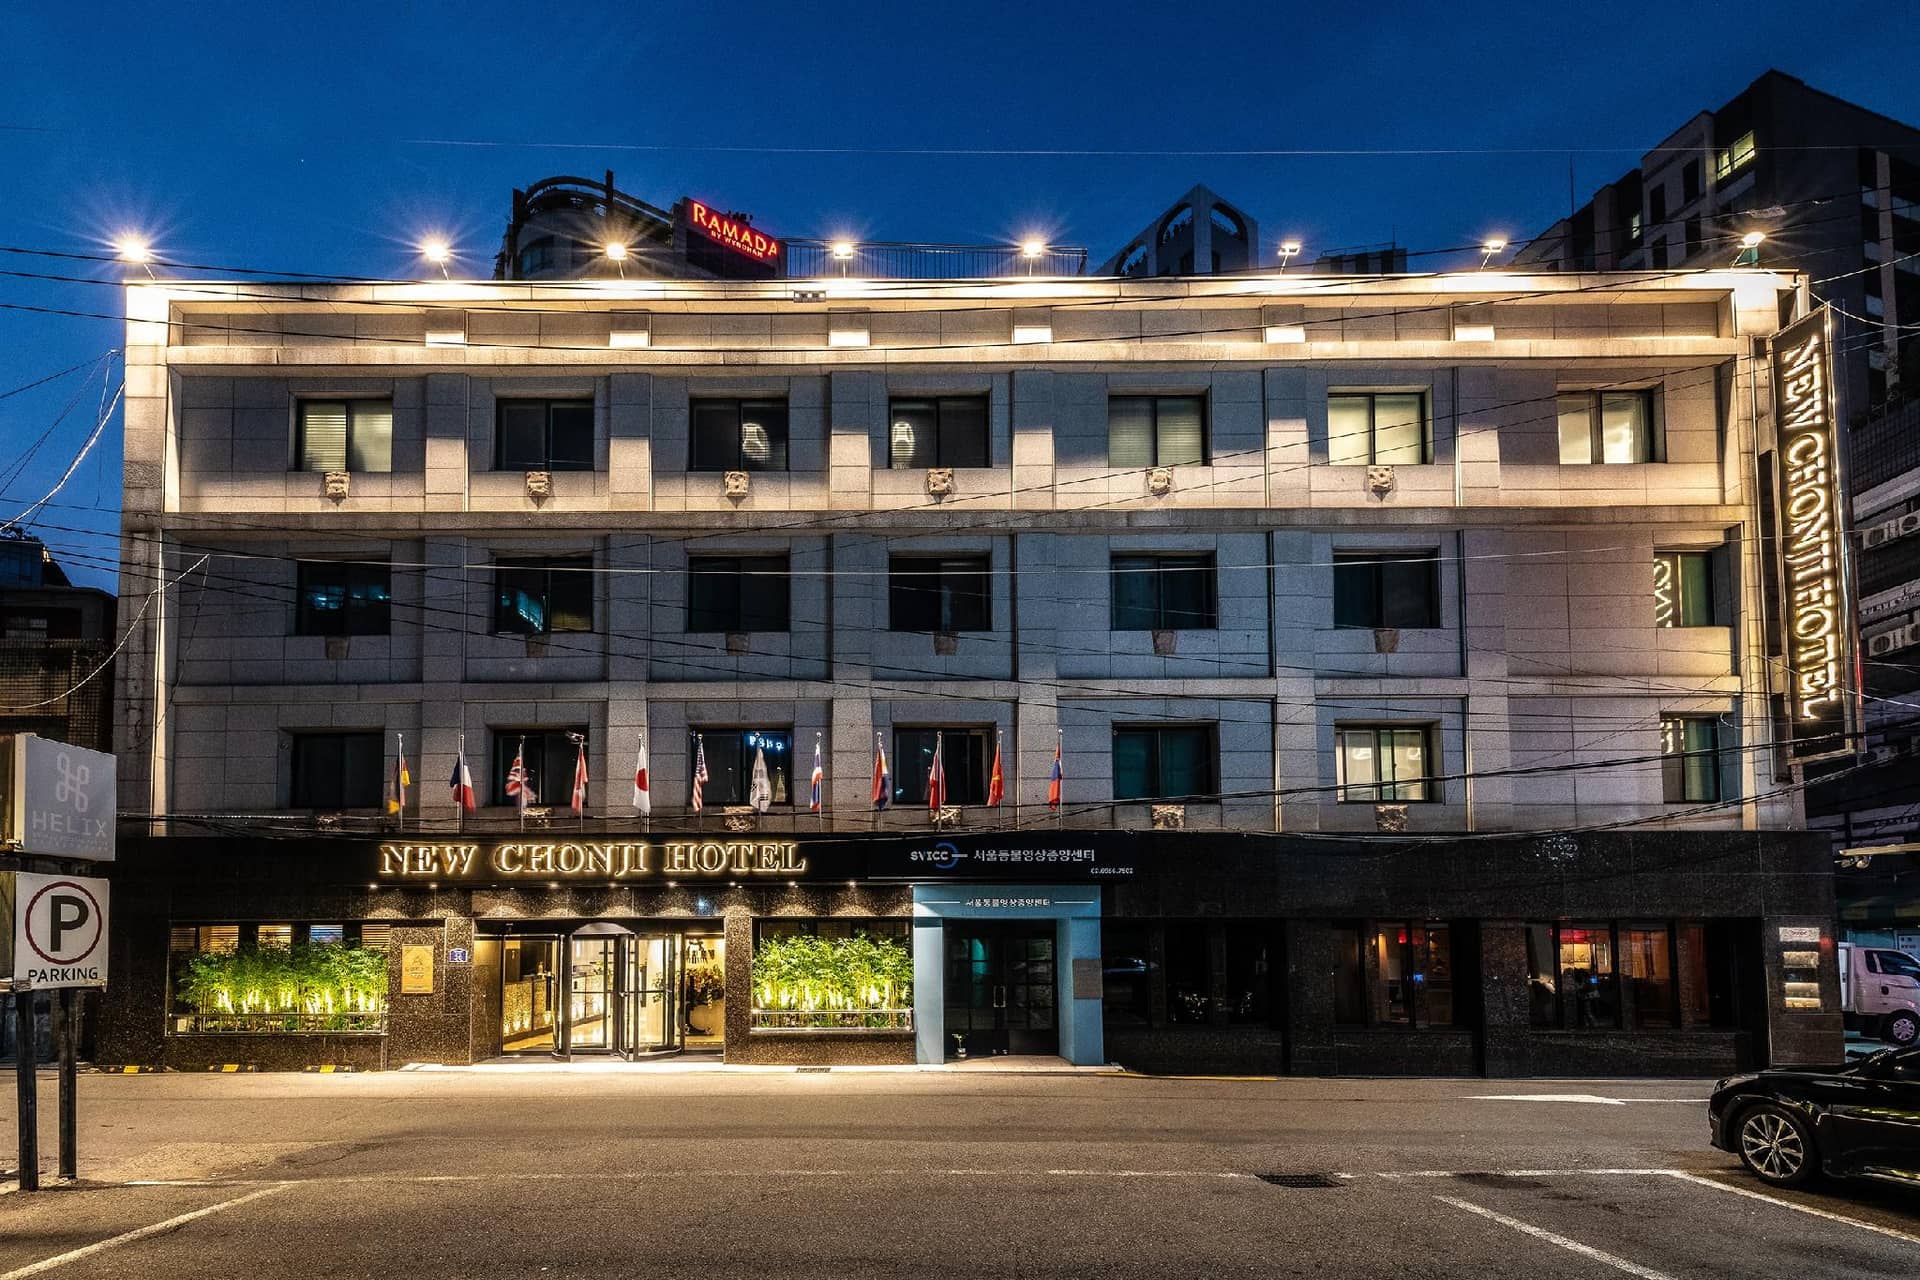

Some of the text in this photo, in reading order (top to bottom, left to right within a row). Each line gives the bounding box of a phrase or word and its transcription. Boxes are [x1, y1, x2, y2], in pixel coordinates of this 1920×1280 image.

[693, 203, 777, 256] RAMADA
[711, 230, 763, 258] BY WYNDHAM
[1781, 334, 1837, 721] NEW CHONJI HOTEL
[32, 810, 107, 838] HELIX
[380, 843, 807, 877] NEW CHONJI HOTEL
[910, 851, 949, 861] SVICC
[50, 895, 89, 952] P
[28, 966, 98, 983] PARKING
